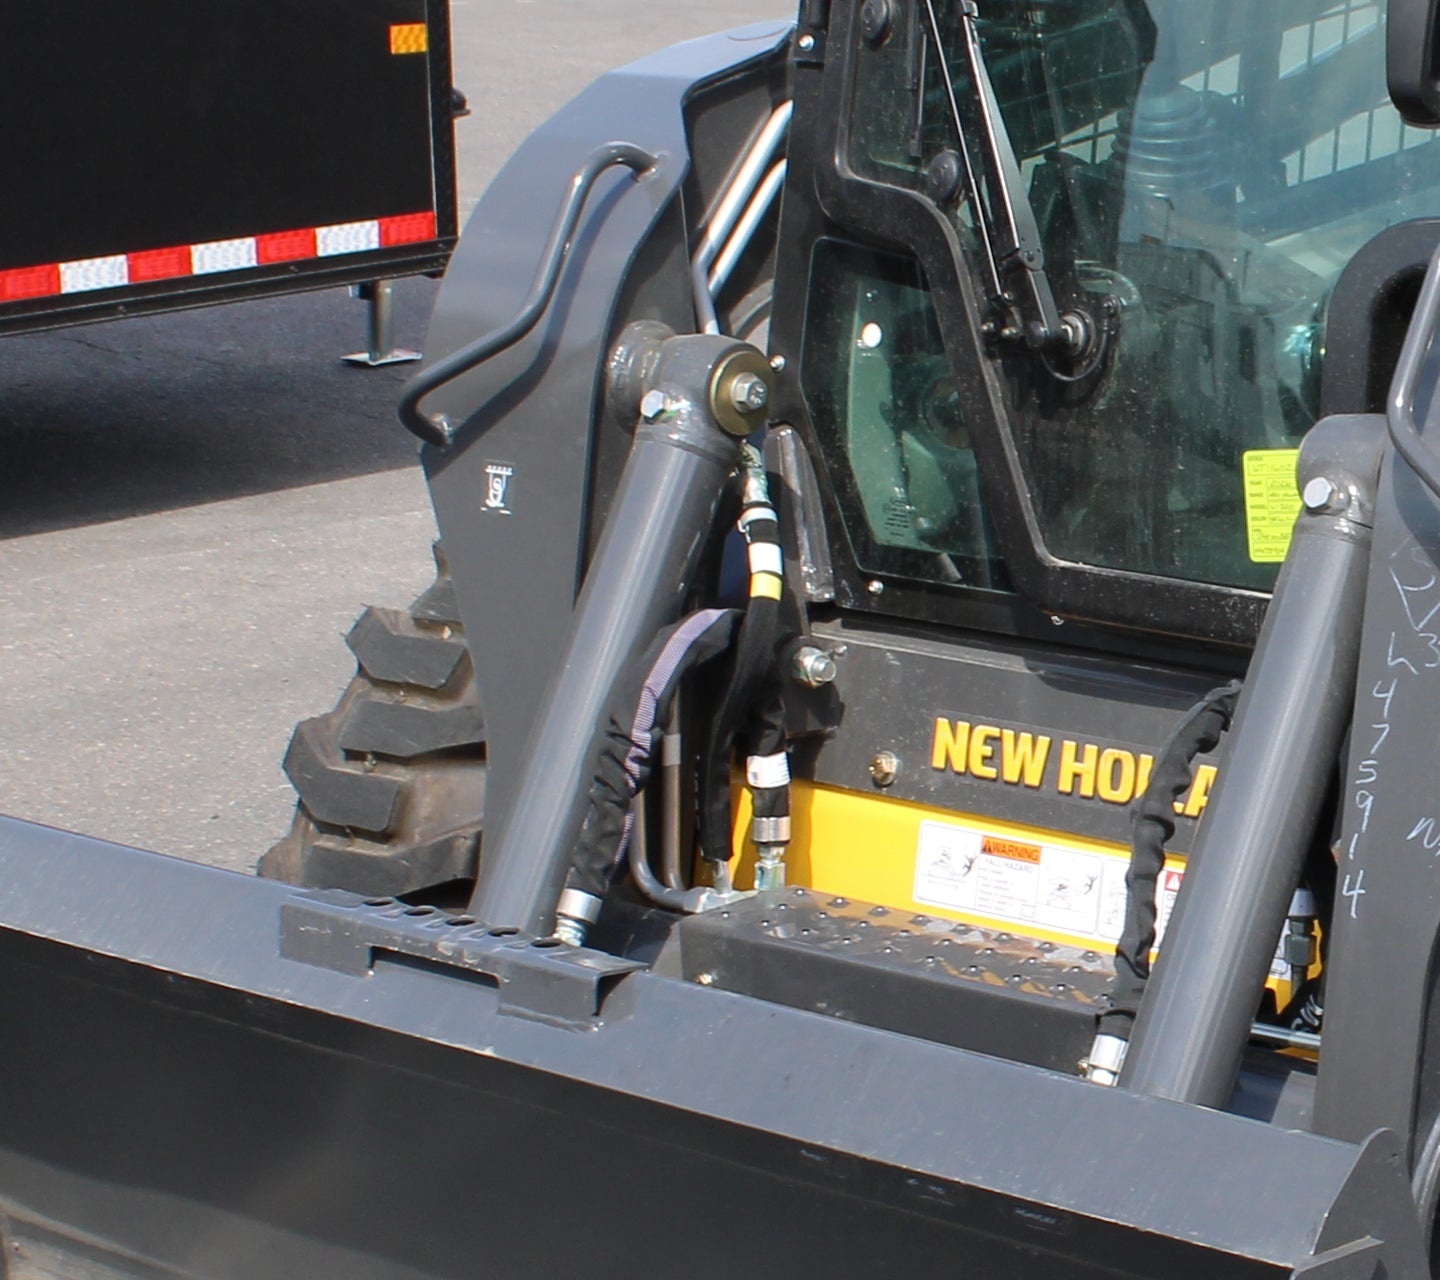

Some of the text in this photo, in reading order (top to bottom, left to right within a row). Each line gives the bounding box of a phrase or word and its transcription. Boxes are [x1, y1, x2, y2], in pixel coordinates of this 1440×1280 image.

[930, 716, 1052, 788] NEW
[992, 840, 1040, 862] WARNING
[1003, 860, 1035, 874] HAZARD
